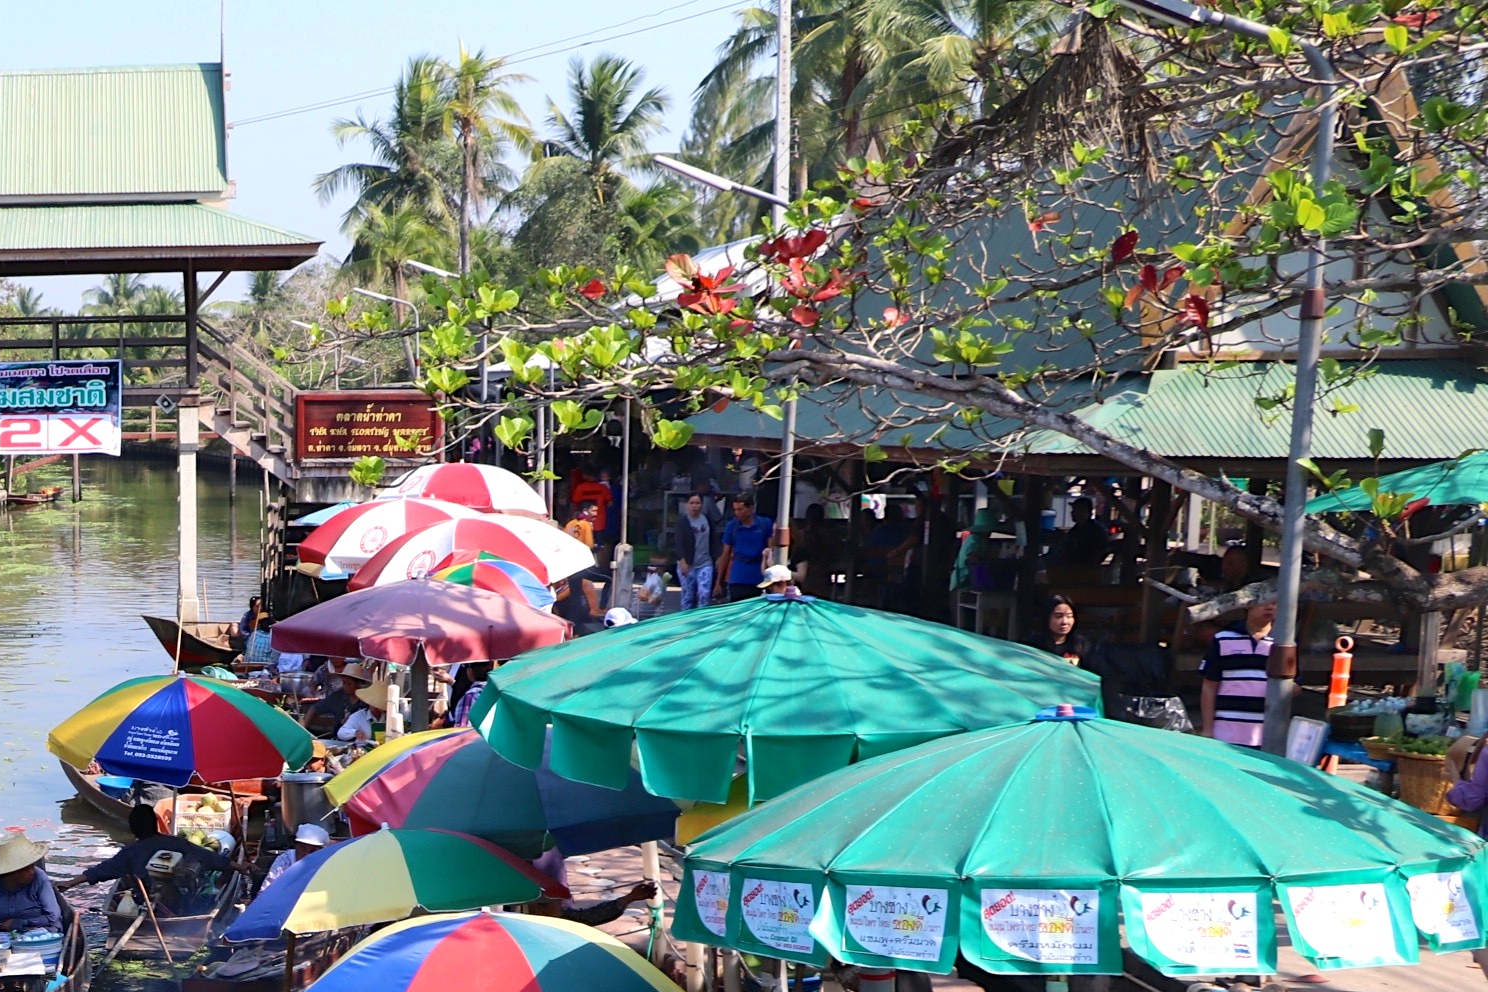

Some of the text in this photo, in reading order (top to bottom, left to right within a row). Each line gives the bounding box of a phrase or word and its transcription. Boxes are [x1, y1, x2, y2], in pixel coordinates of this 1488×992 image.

[336, 403, 402, 422] ตลาดน้ำท่าคา
[0, 418, 42, 448] 2
[309, 427, 327, 436] THA
[330, 427, 348, 436] KHA
[350, 427, 390, 437] FLOATING
